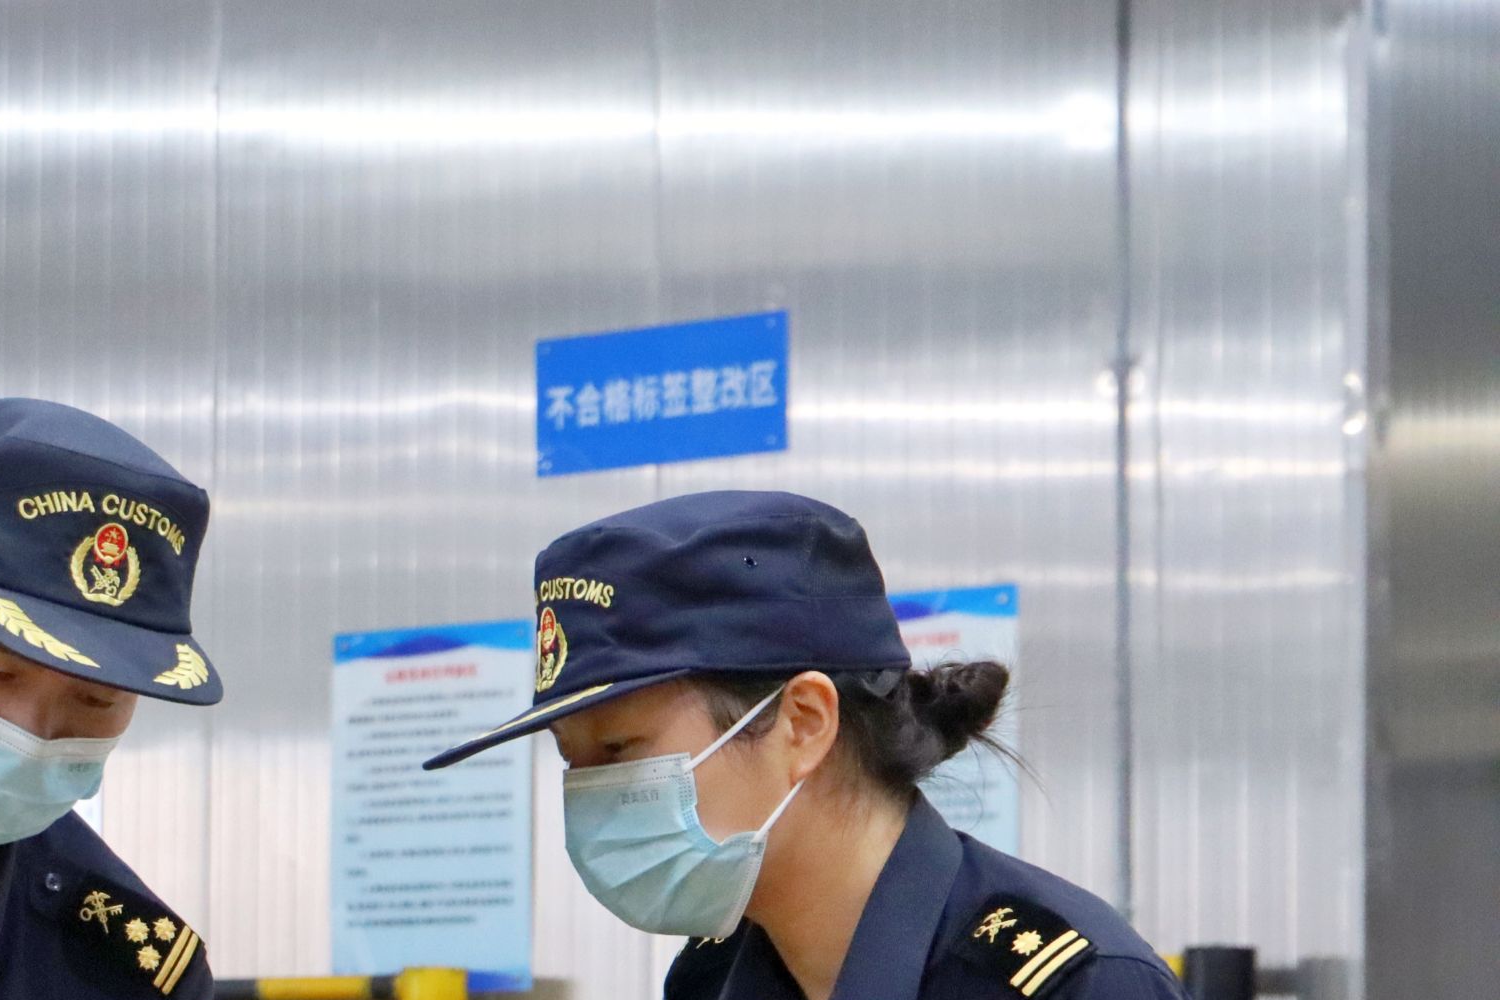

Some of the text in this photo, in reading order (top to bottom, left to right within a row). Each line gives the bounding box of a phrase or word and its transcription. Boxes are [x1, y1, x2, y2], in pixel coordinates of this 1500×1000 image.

[18, 491, 185, 556] CHINA CUSTOMS
[540, 578, 614, 608] CUSTOMS
